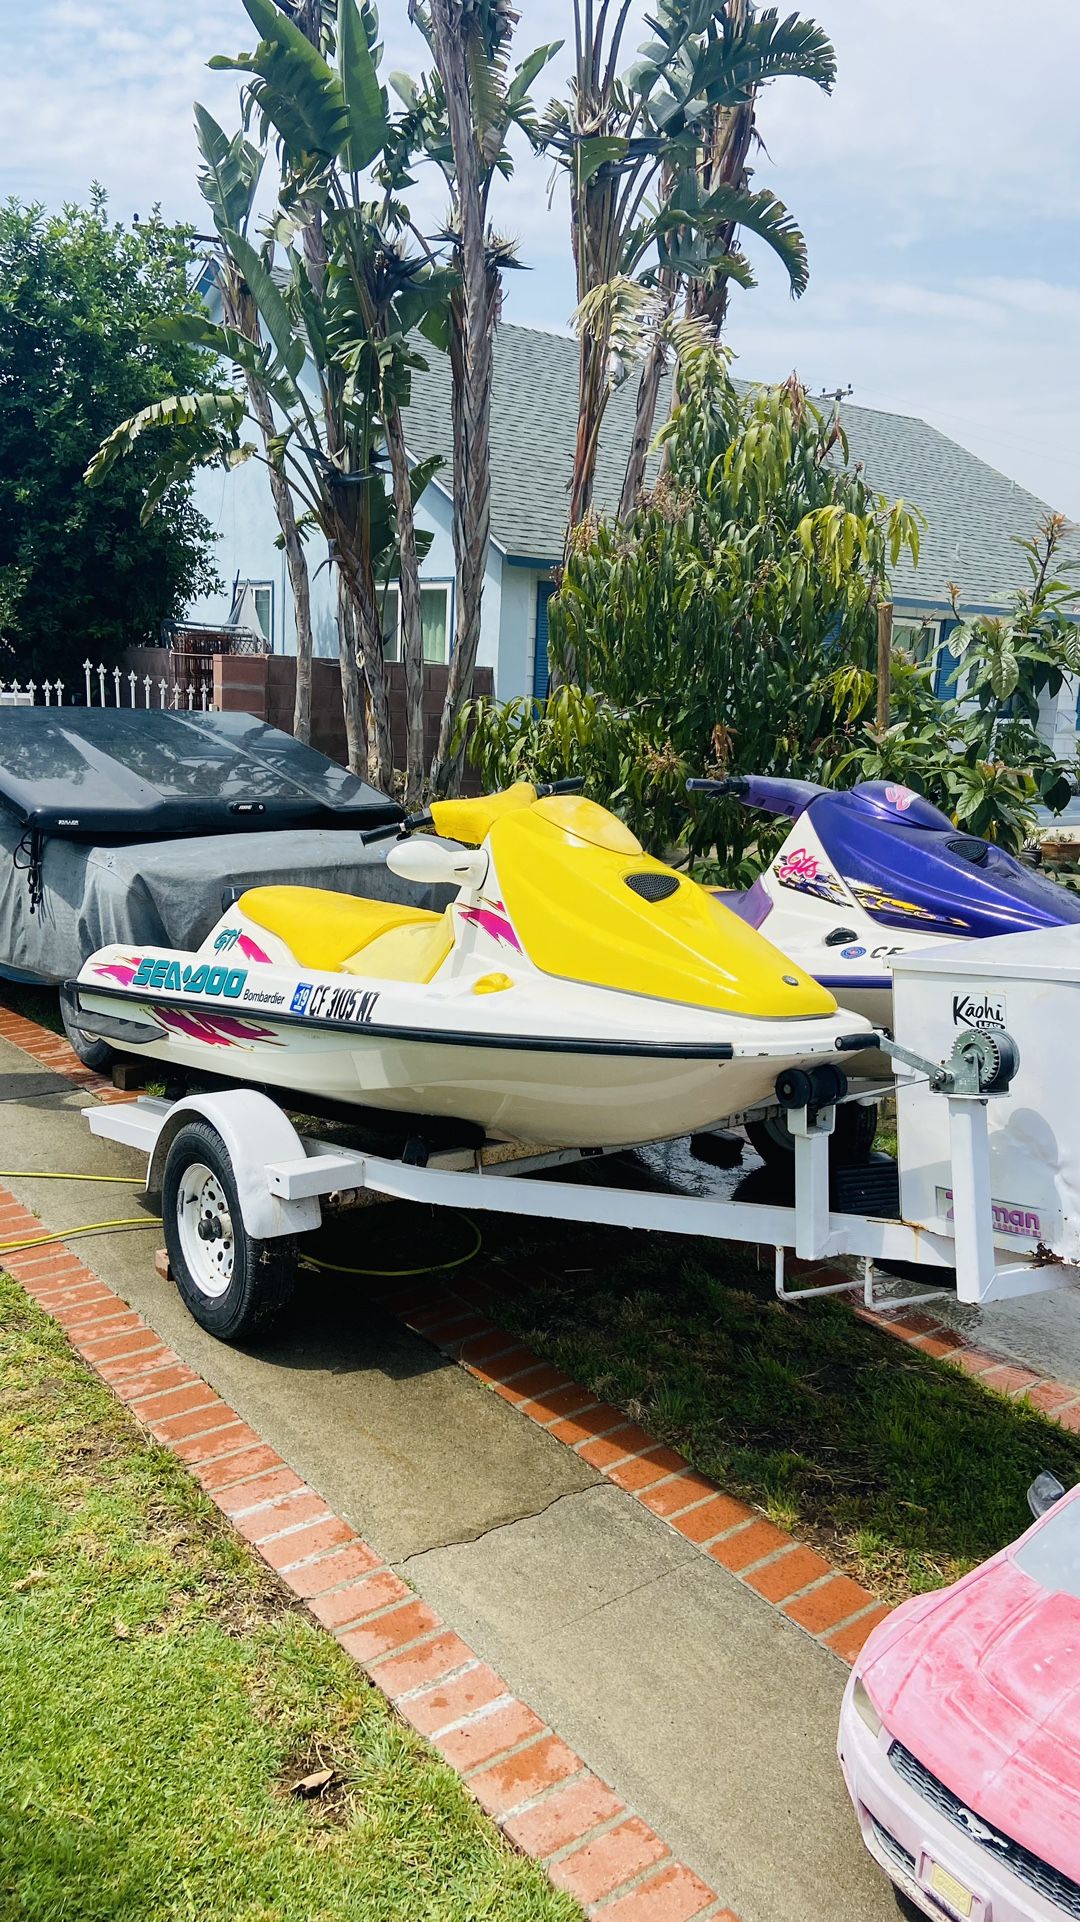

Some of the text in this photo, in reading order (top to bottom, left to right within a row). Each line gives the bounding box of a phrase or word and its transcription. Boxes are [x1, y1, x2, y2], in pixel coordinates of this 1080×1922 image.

[243, 989, 286, 1005] Bombardier
[309, 984, 331, 1017] CF
[326, 987, 362, 1020] 3105
